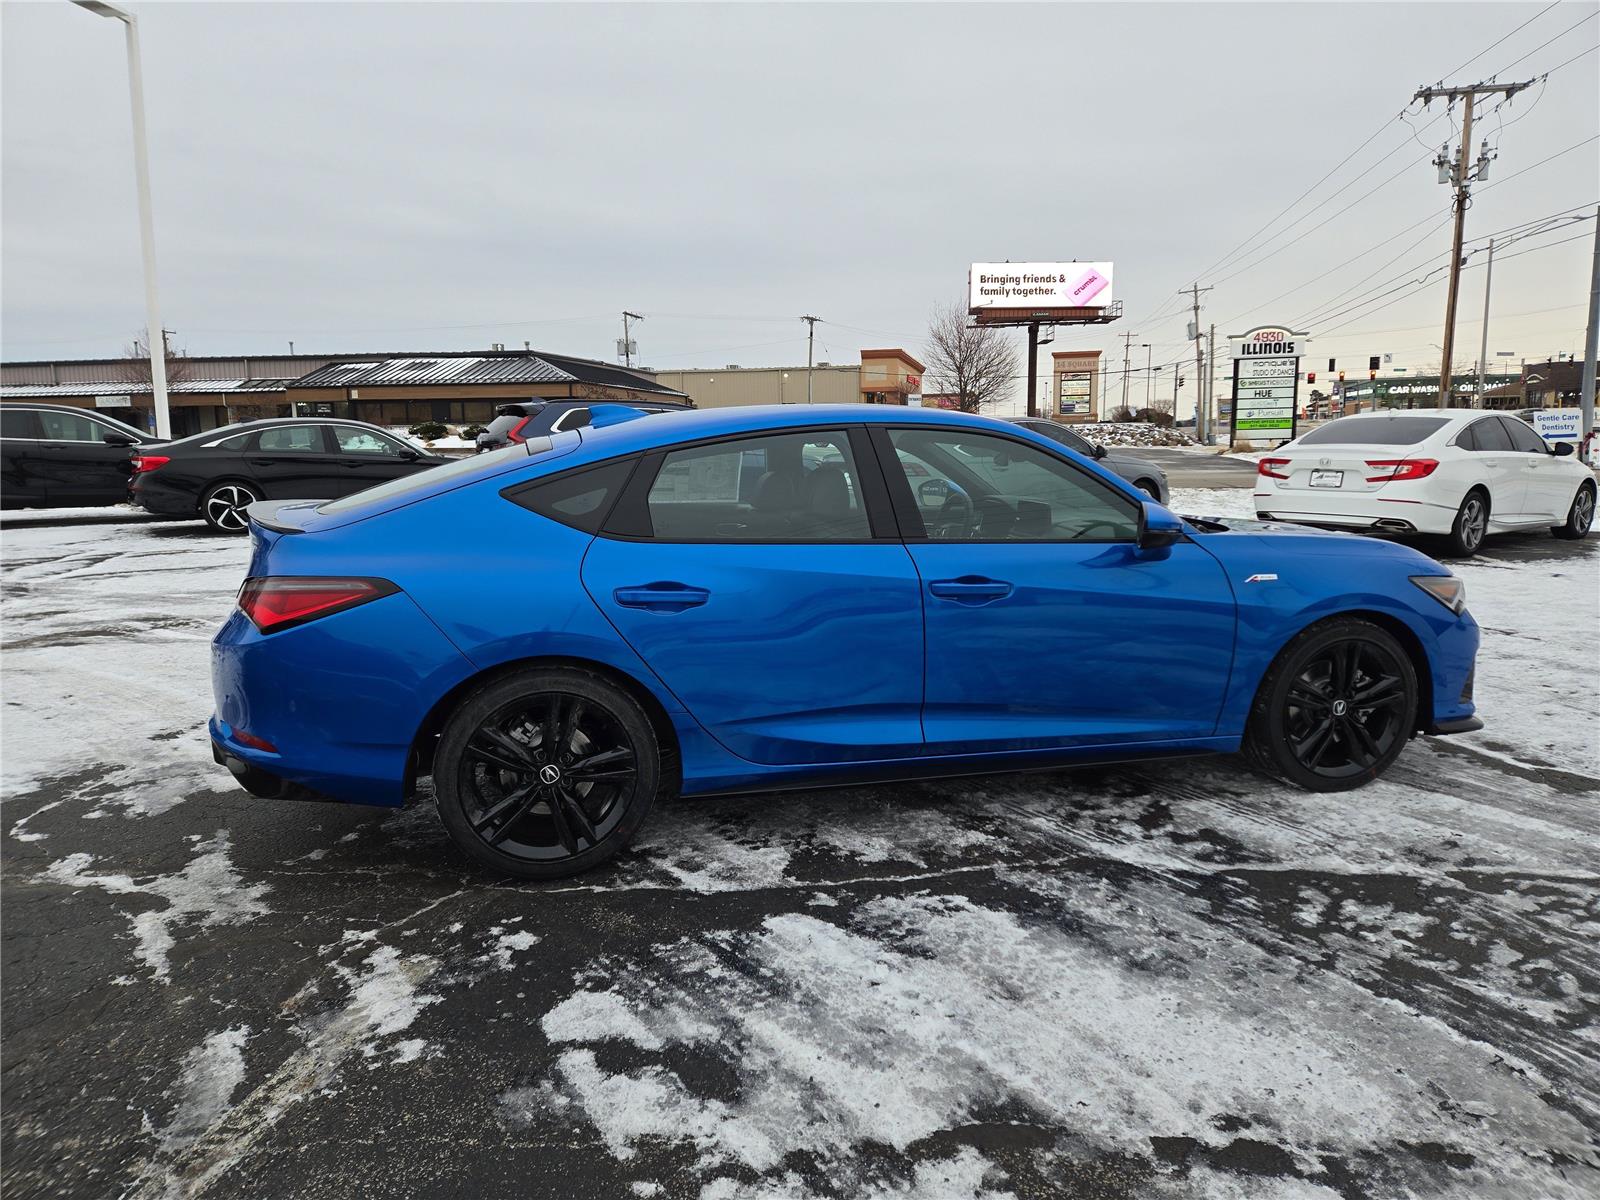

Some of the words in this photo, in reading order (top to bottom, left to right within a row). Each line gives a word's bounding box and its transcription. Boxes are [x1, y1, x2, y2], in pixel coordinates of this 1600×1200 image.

[980, 274, 1021, 285] Bringing
[1022, 274, 1057, 283] friends
[1059, 274, 1066, 283] &
[1073, 275, 1098, 296] crumbl
[980, 286, 1010, 297] family
[1012, 287, 1057, 297] together.
[1253, 332, 1284, 342] 4930
[1242, 342, 1295, 355] ILLINOIS
[1252, 359, 1295, 367] monique's
[1388, 386, 1410, 394] CAR
[1411, 385, 1439, 393] WASH
[1258, 409, 1284, 417] Pursuit
[1537, 414, 1559, 422] Gentle
[1542, 423, 1575, 431] Dentistry
